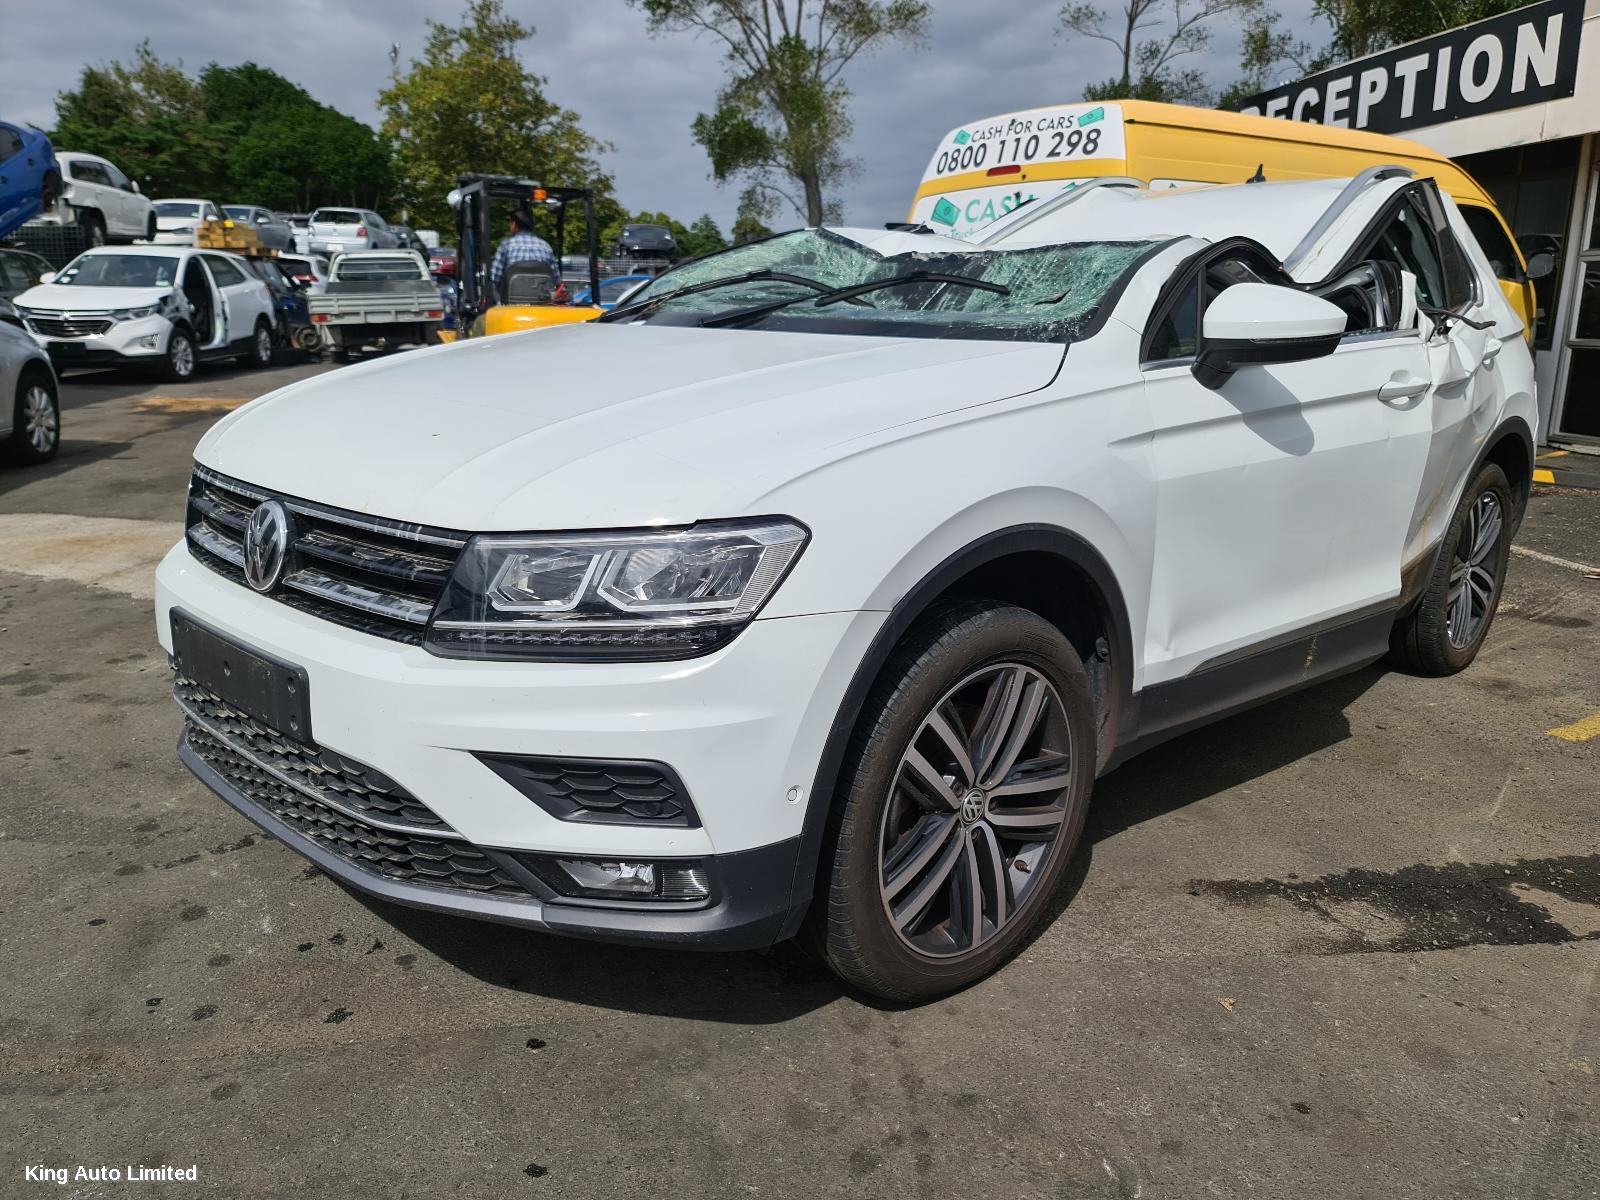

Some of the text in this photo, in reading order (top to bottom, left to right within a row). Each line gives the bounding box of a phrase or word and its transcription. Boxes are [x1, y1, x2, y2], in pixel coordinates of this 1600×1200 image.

[1239, 13, 1564, 129] CEPTION
[936, 128, 1102, 175] 0800 110 298
[971, 115, 1075, 143] CASH FOR CARS
